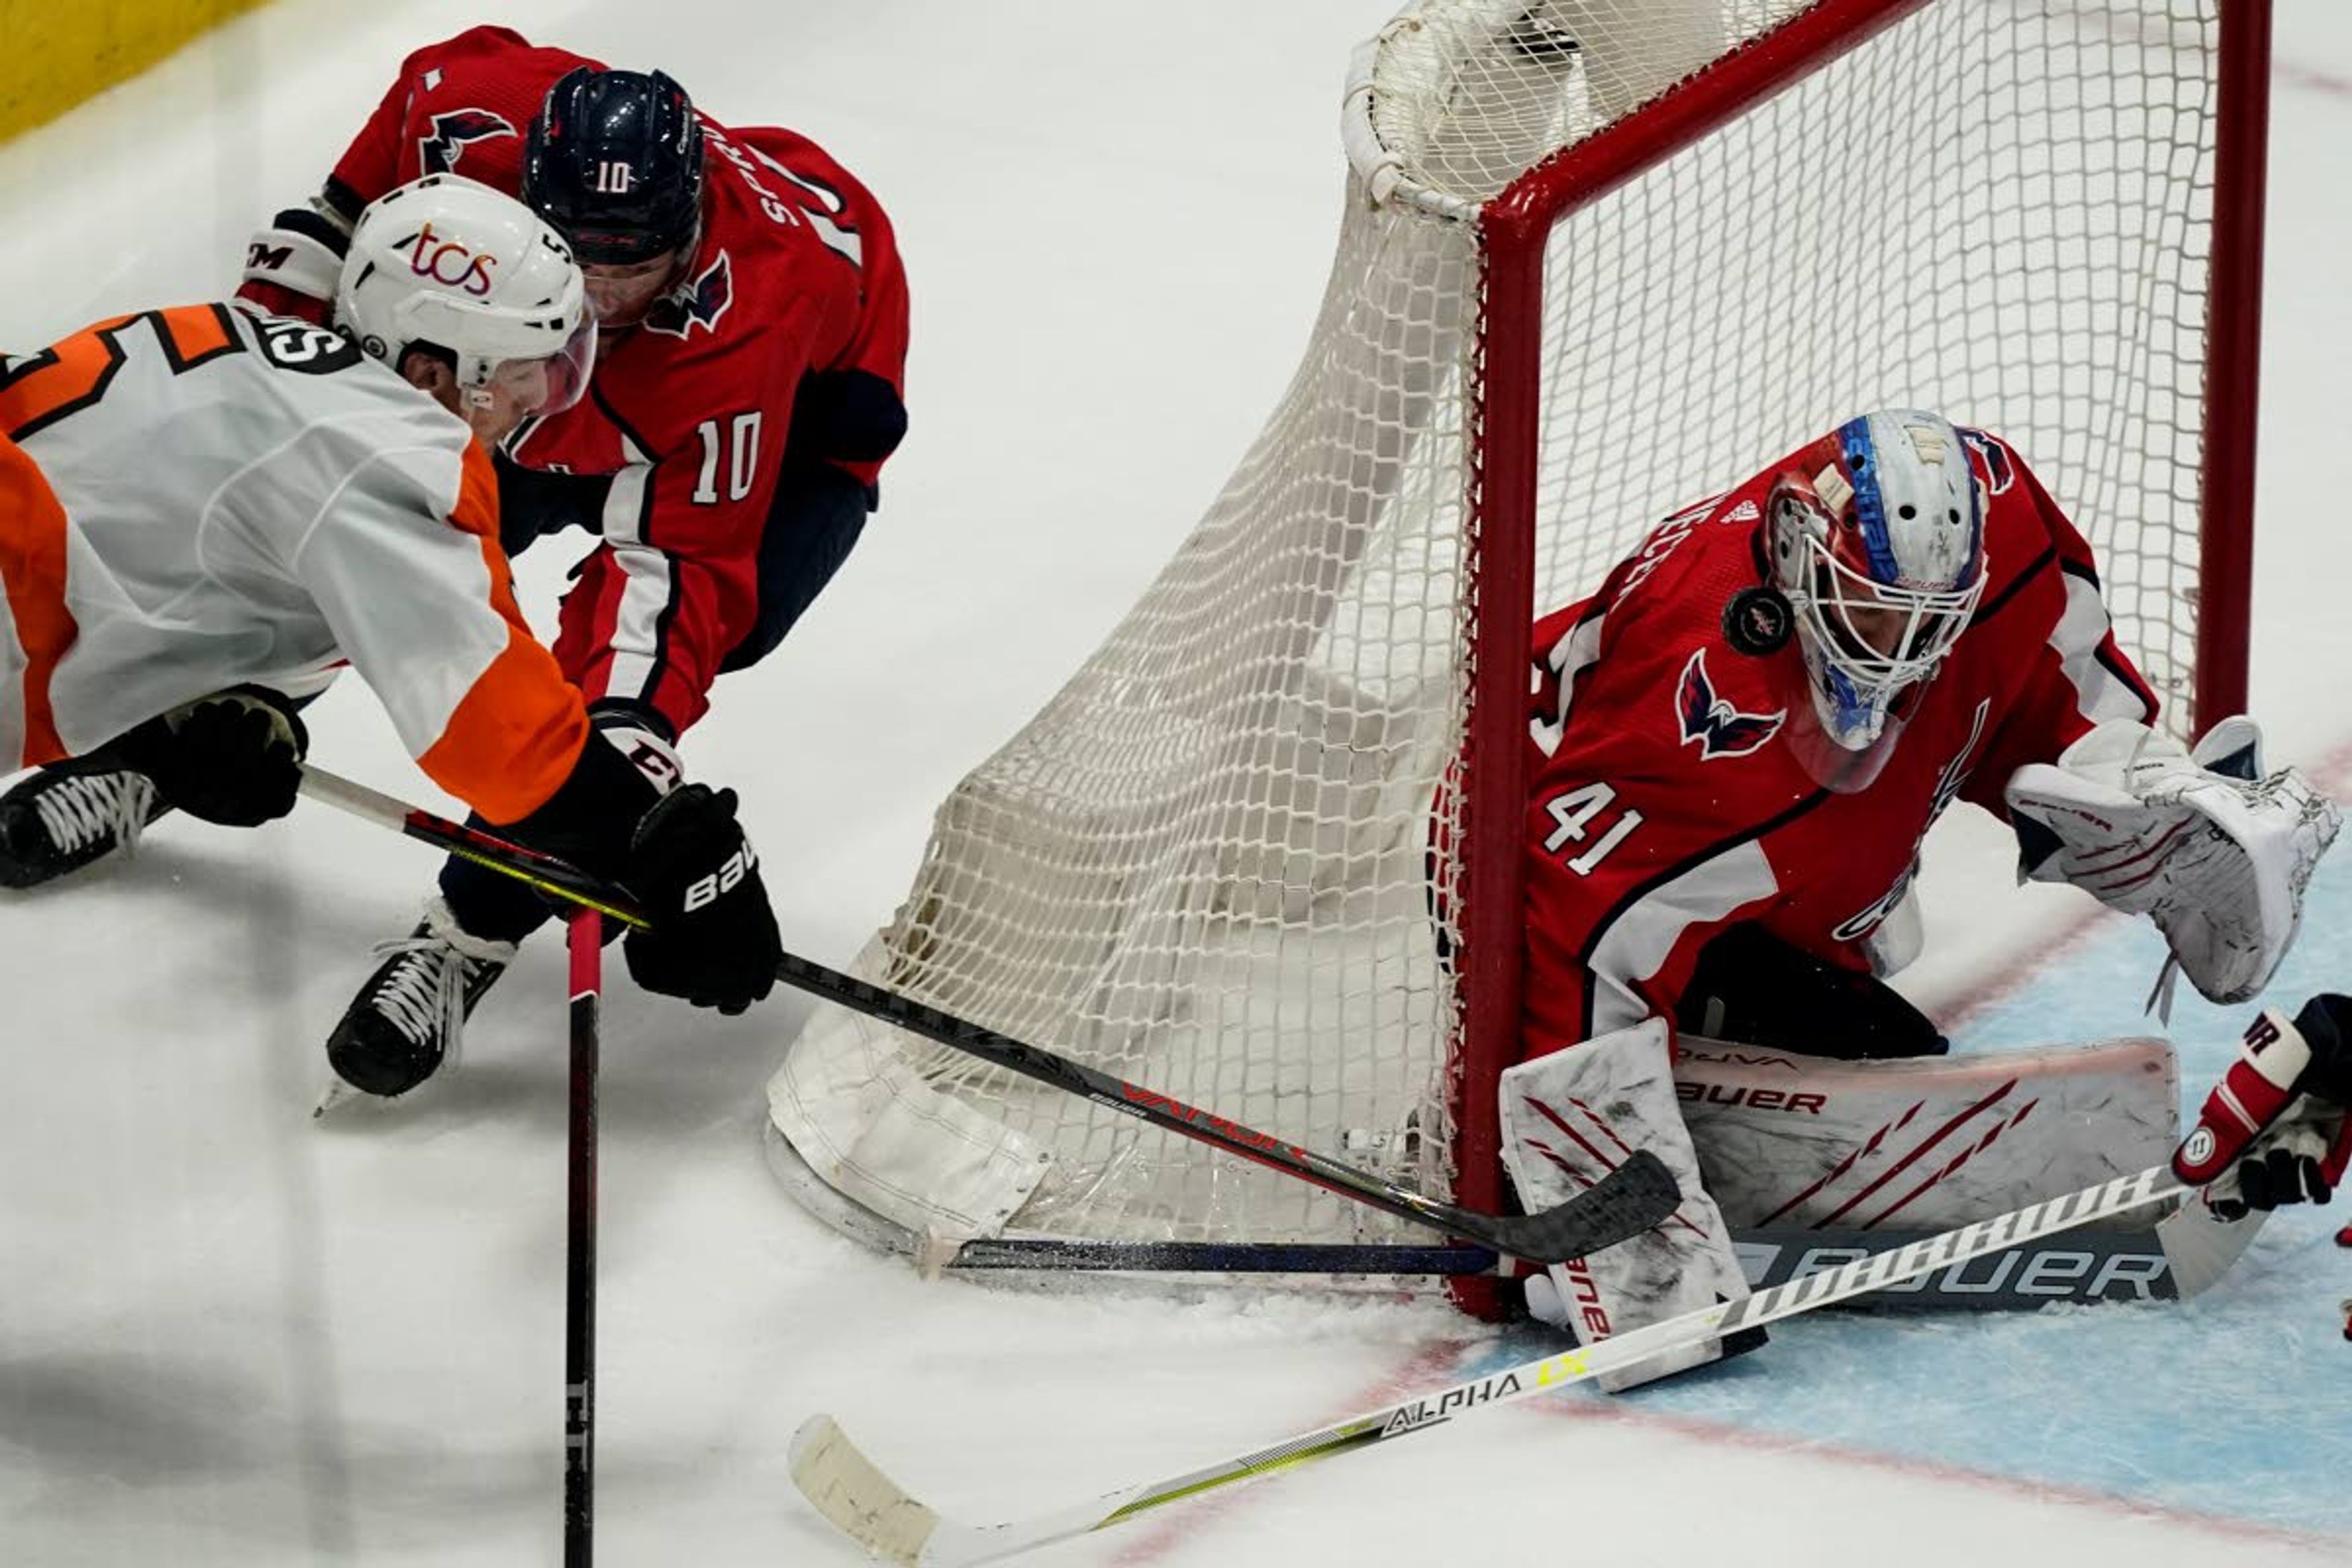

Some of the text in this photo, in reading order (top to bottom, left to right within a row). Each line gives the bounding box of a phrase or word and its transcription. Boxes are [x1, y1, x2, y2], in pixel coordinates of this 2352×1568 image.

[597, 162, 630, 193] 10
[411, 222, 497, 296] tcs
[693, 410, 762, 503] 10
[1544, 782, 1645, 876] 41
[1674, 1081, 1827, 1115] AUER
[1381, 1373, 1521, 1438] ALPHA
